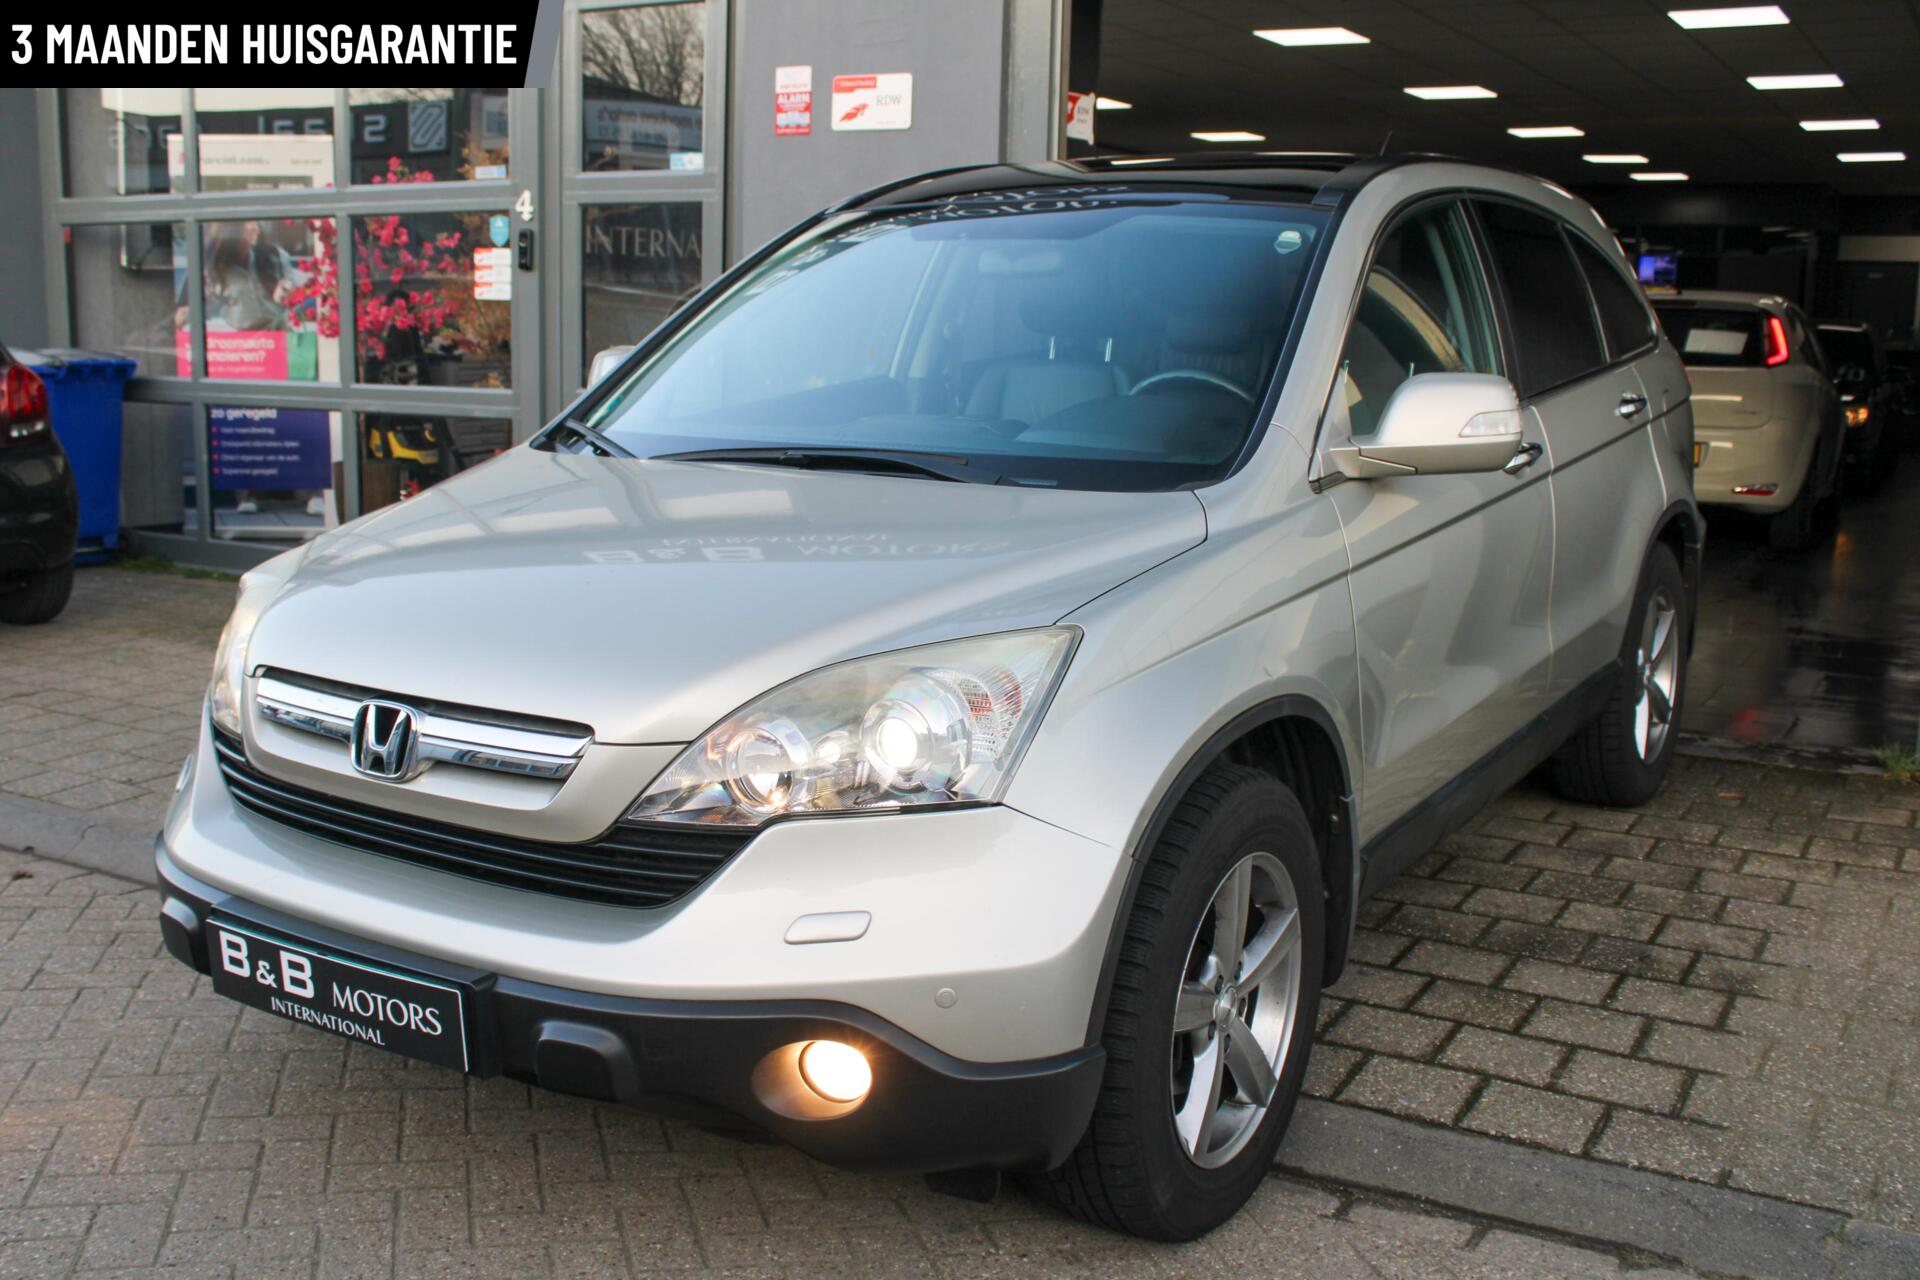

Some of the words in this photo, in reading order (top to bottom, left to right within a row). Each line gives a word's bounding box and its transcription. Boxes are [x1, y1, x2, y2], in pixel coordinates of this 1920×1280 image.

[876, 95, 910, 107] RDW
[515, 189, 534, 221] 4
[270, 996, 386, 1047] INTERNATIONAL
[332, 980, 443, 1036] MOTORS
